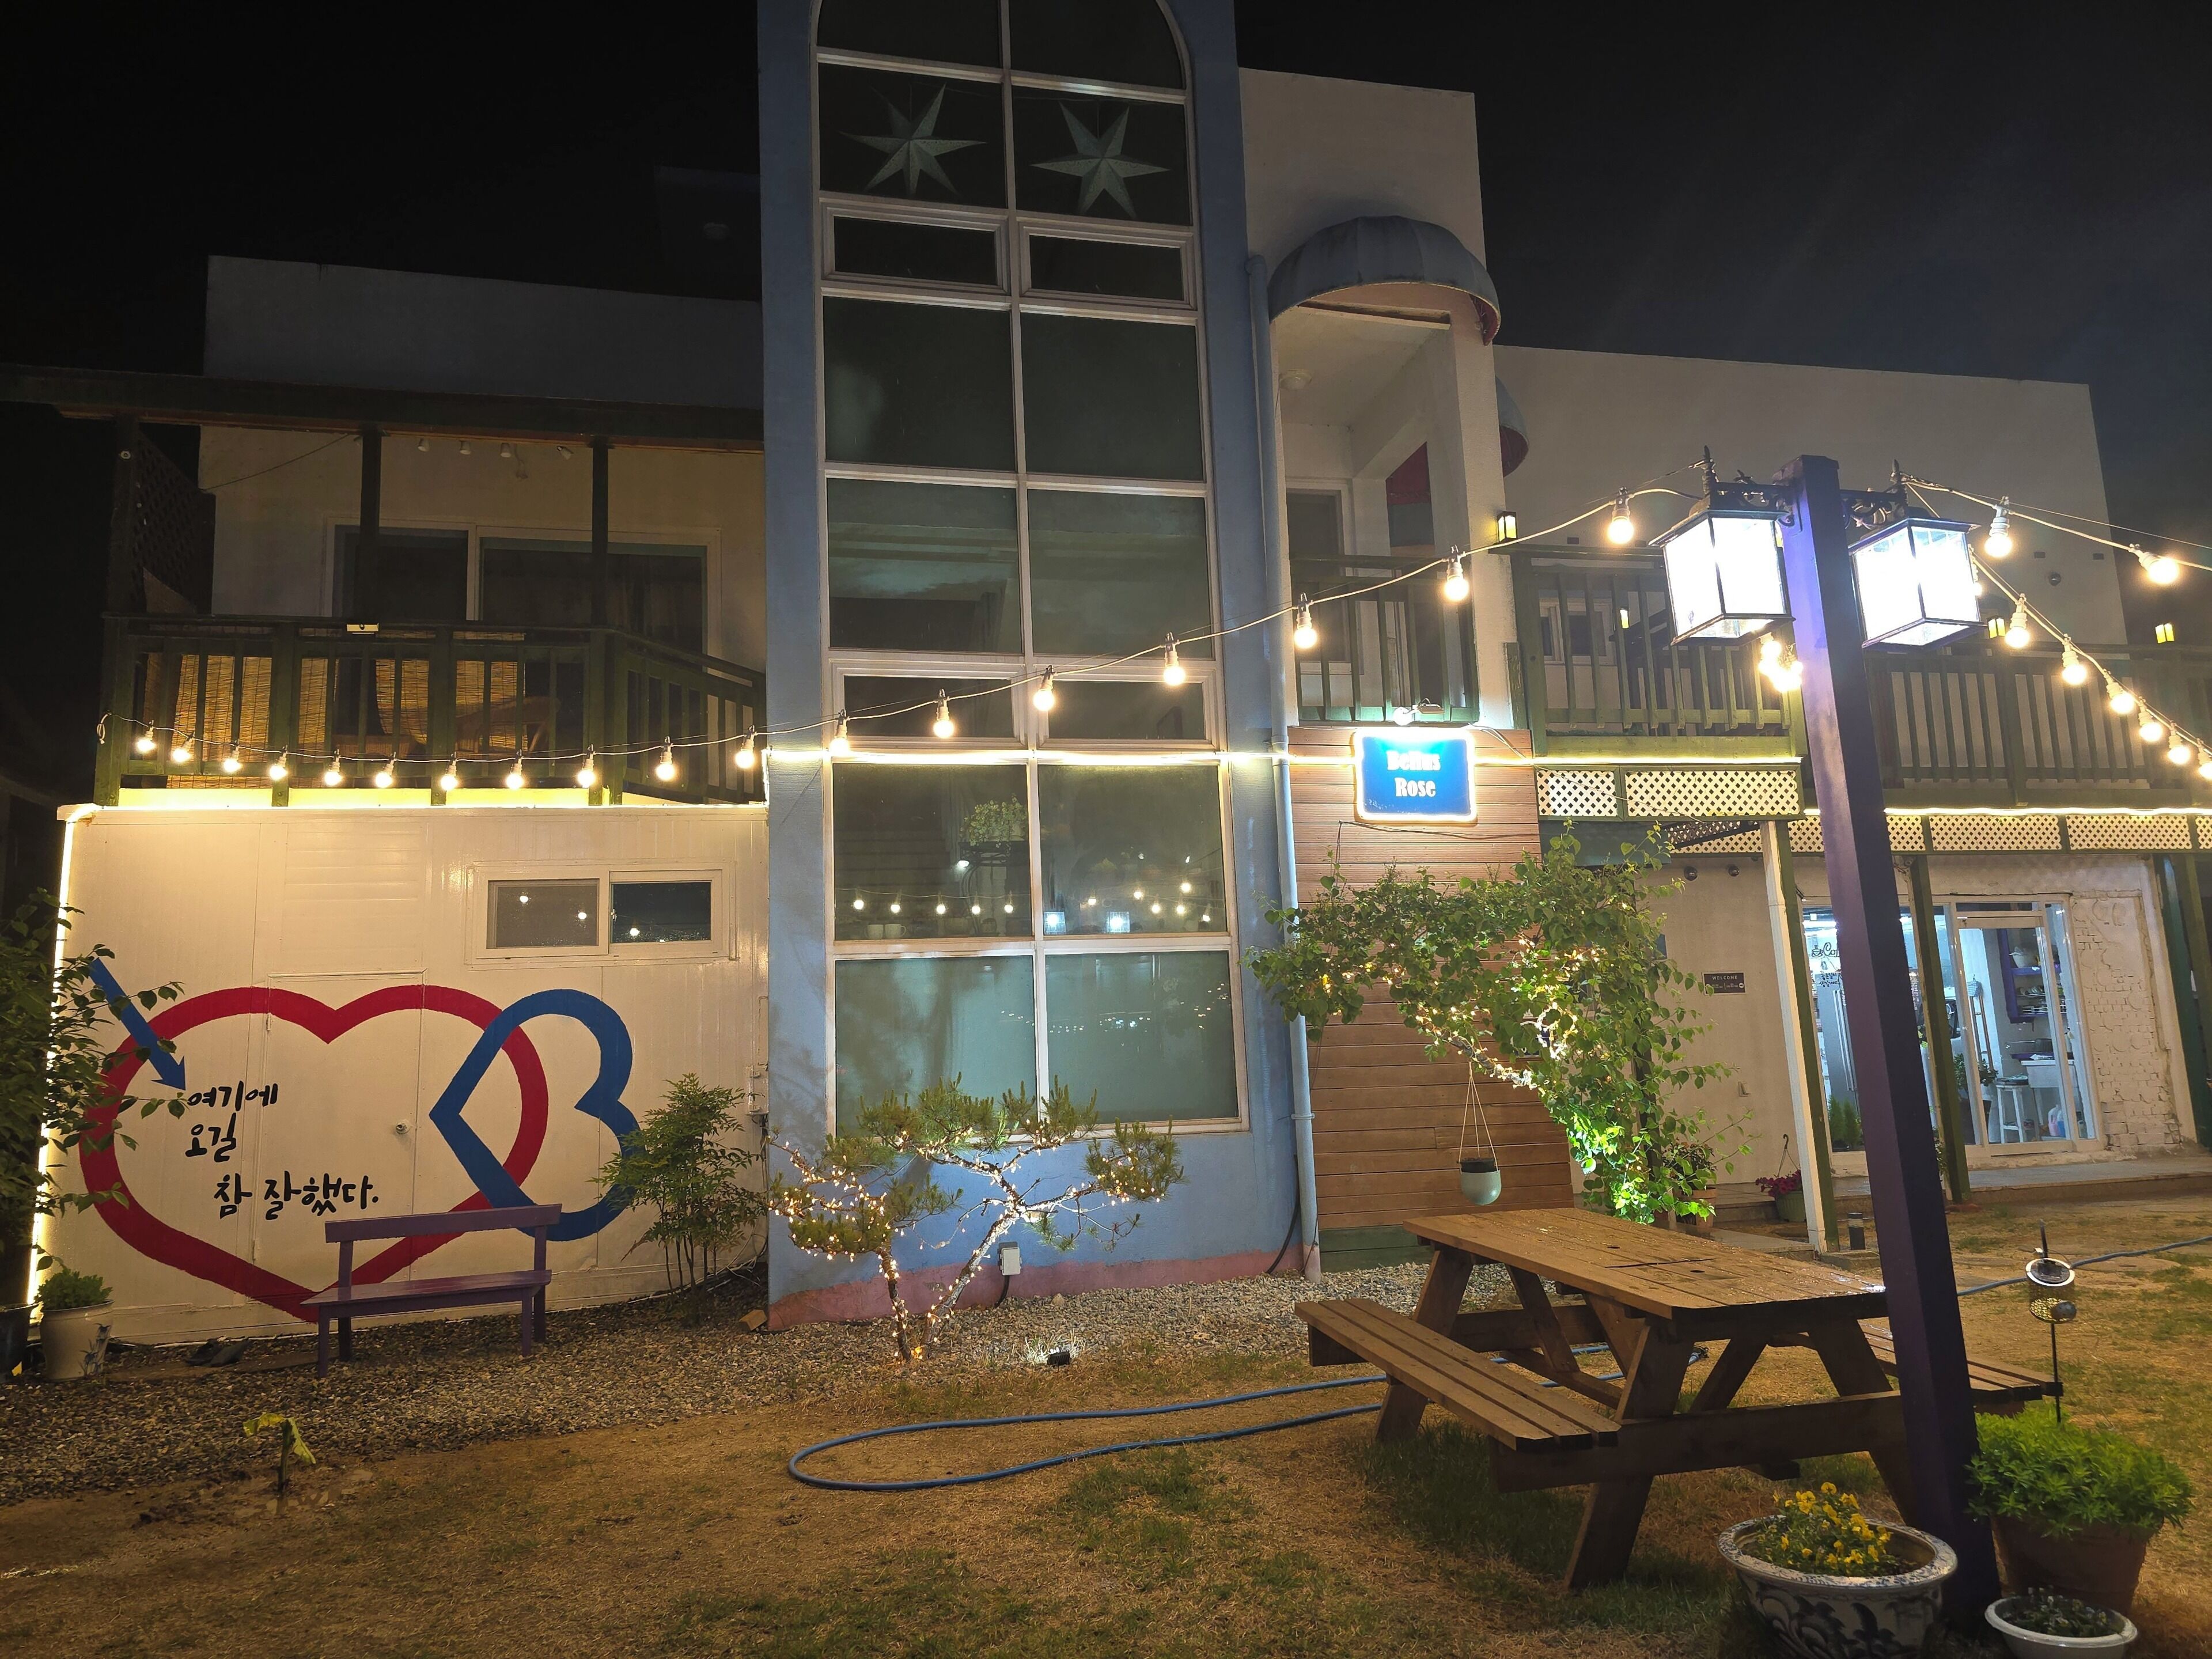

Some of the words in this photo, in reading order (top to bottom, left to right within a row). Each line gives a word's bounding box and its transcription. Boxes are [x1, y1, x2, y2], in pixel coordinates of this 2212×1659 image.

[1395, 777, 1436, 797] Rose
[187, 1081, 278, 1111] 여기에
[185, 1112, 237, 1162] 오길
[214, 1173, 252, 1219] 참
[264, 1171, 379, 1220] 잘했다.
